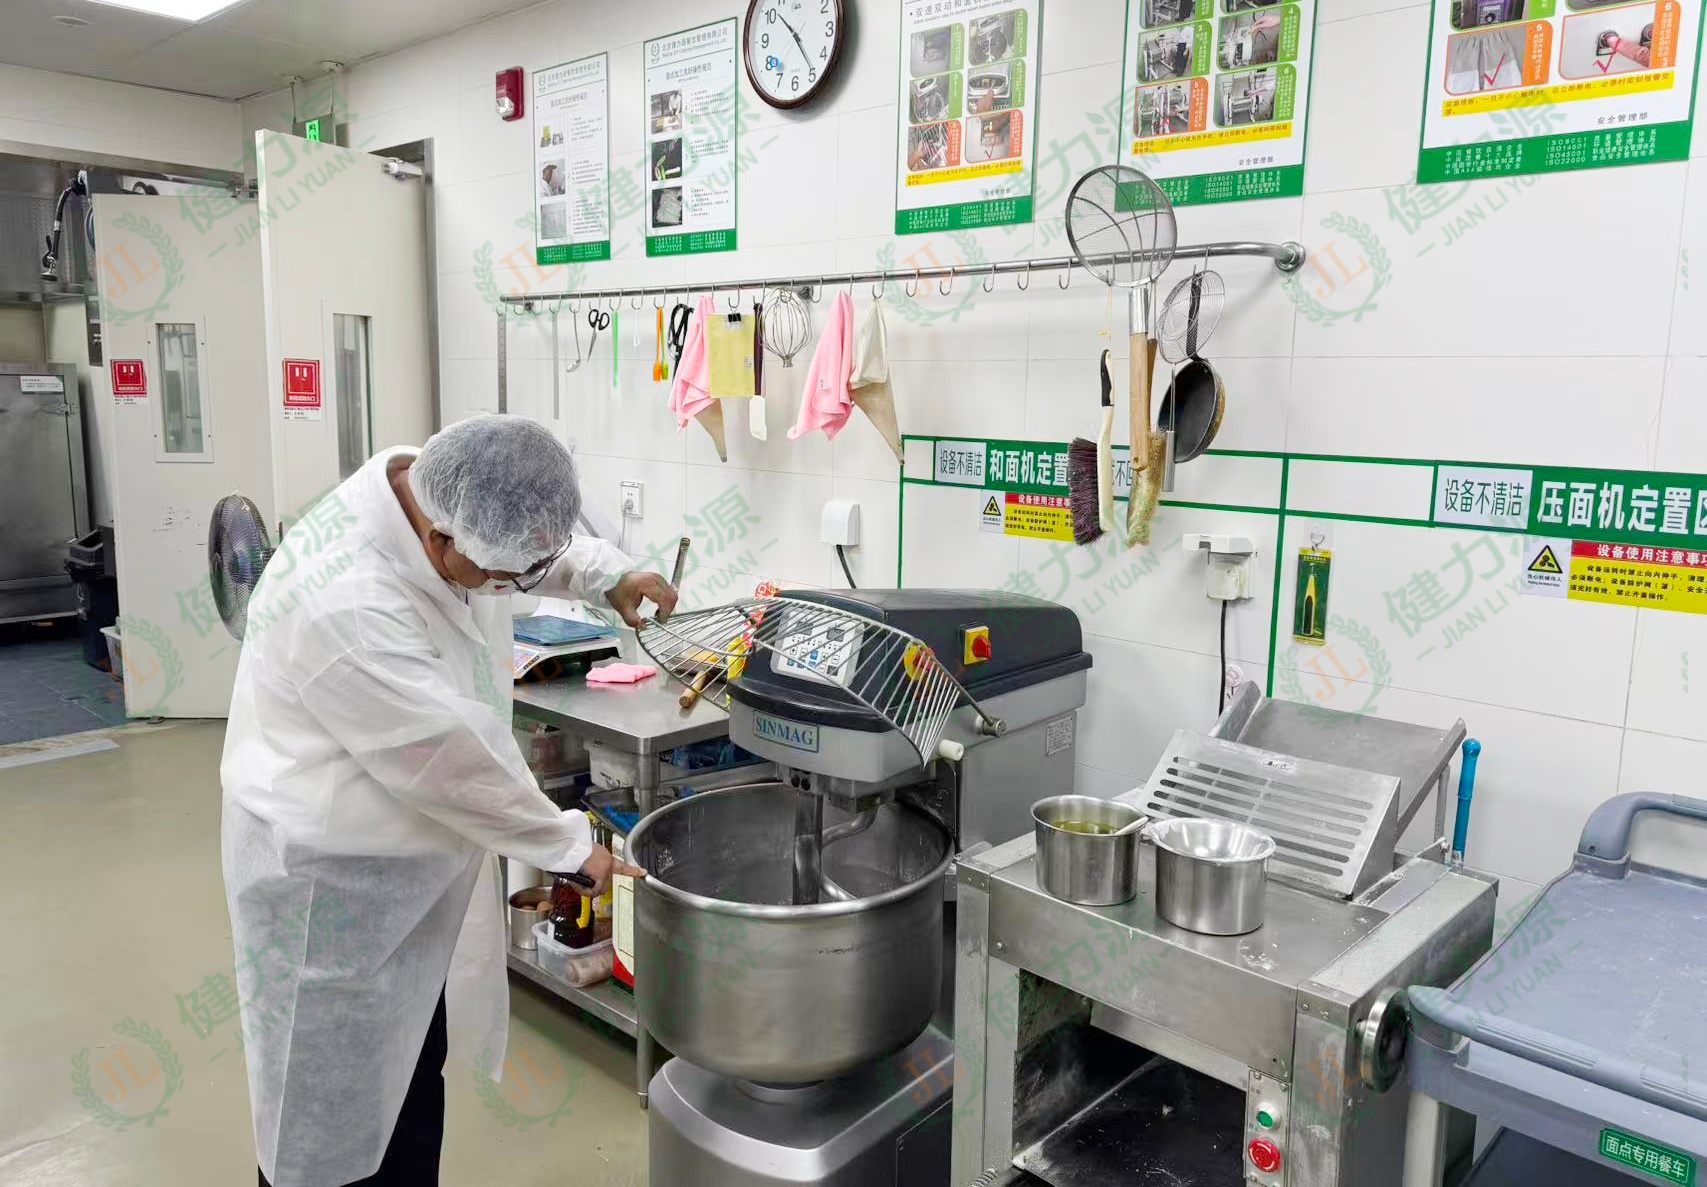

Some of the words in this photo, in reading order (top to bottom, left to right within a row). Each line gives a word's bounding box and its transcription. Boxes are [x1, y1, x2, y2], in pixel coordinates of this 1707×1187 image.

[820, 0, 829, 14] 2
[1665, 2, 1672, 11] 6
[765, 8, 776, 25] 10
[825, 21, 834, 37] 3
[1536, 23, 1543, 32] 5
[761, 33, 769, 49] 9
[819, 46, 828, 60] 4
[765, 56, 773, 71] 8
[776, 73, 784, 88] 7
[808, 68, 816, 83] 5
[791, 76, 799, 91] 6
[1597, 111, 1649, 125] 安全管理部
[940, 448, 982, 476] 设备不清洁
[1444, 477, 1524, 516] 设备不清洁
[755, 717, 814, 745] SINMAG
[1605, 1135, 1686, 1178] 面点专用餐车
